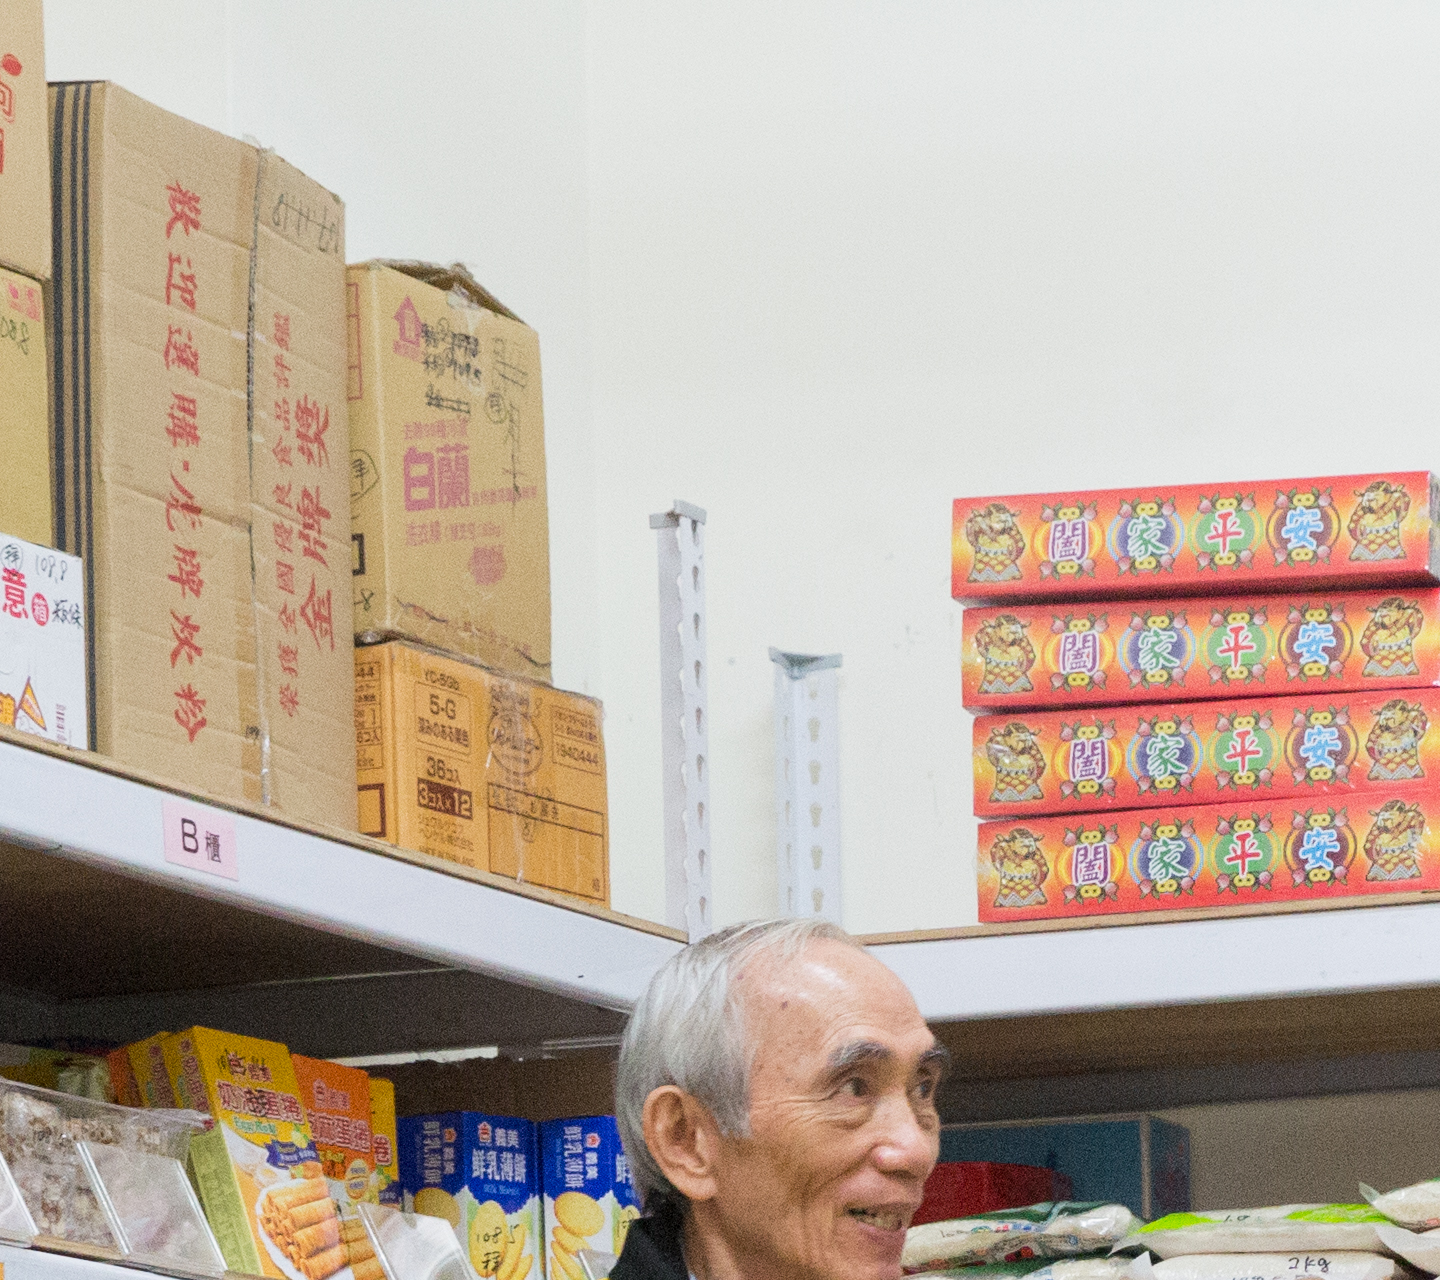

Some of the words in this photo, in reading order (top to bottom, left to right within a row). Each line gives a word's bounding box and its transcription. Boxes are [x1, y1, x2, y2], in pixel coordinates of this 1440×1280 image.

[404, 443, 471, 512] 白蘭
[1048, 505, 1324, 564] 闔家平安
[1061, 620, 1336, 675] 闔家平安
[1069, 724, 1343, 783] 闔家平安
[1073, 826, 1342, 888] 闔家平安
[472, 1149, 526, 1183] 鮮乳薄餅
